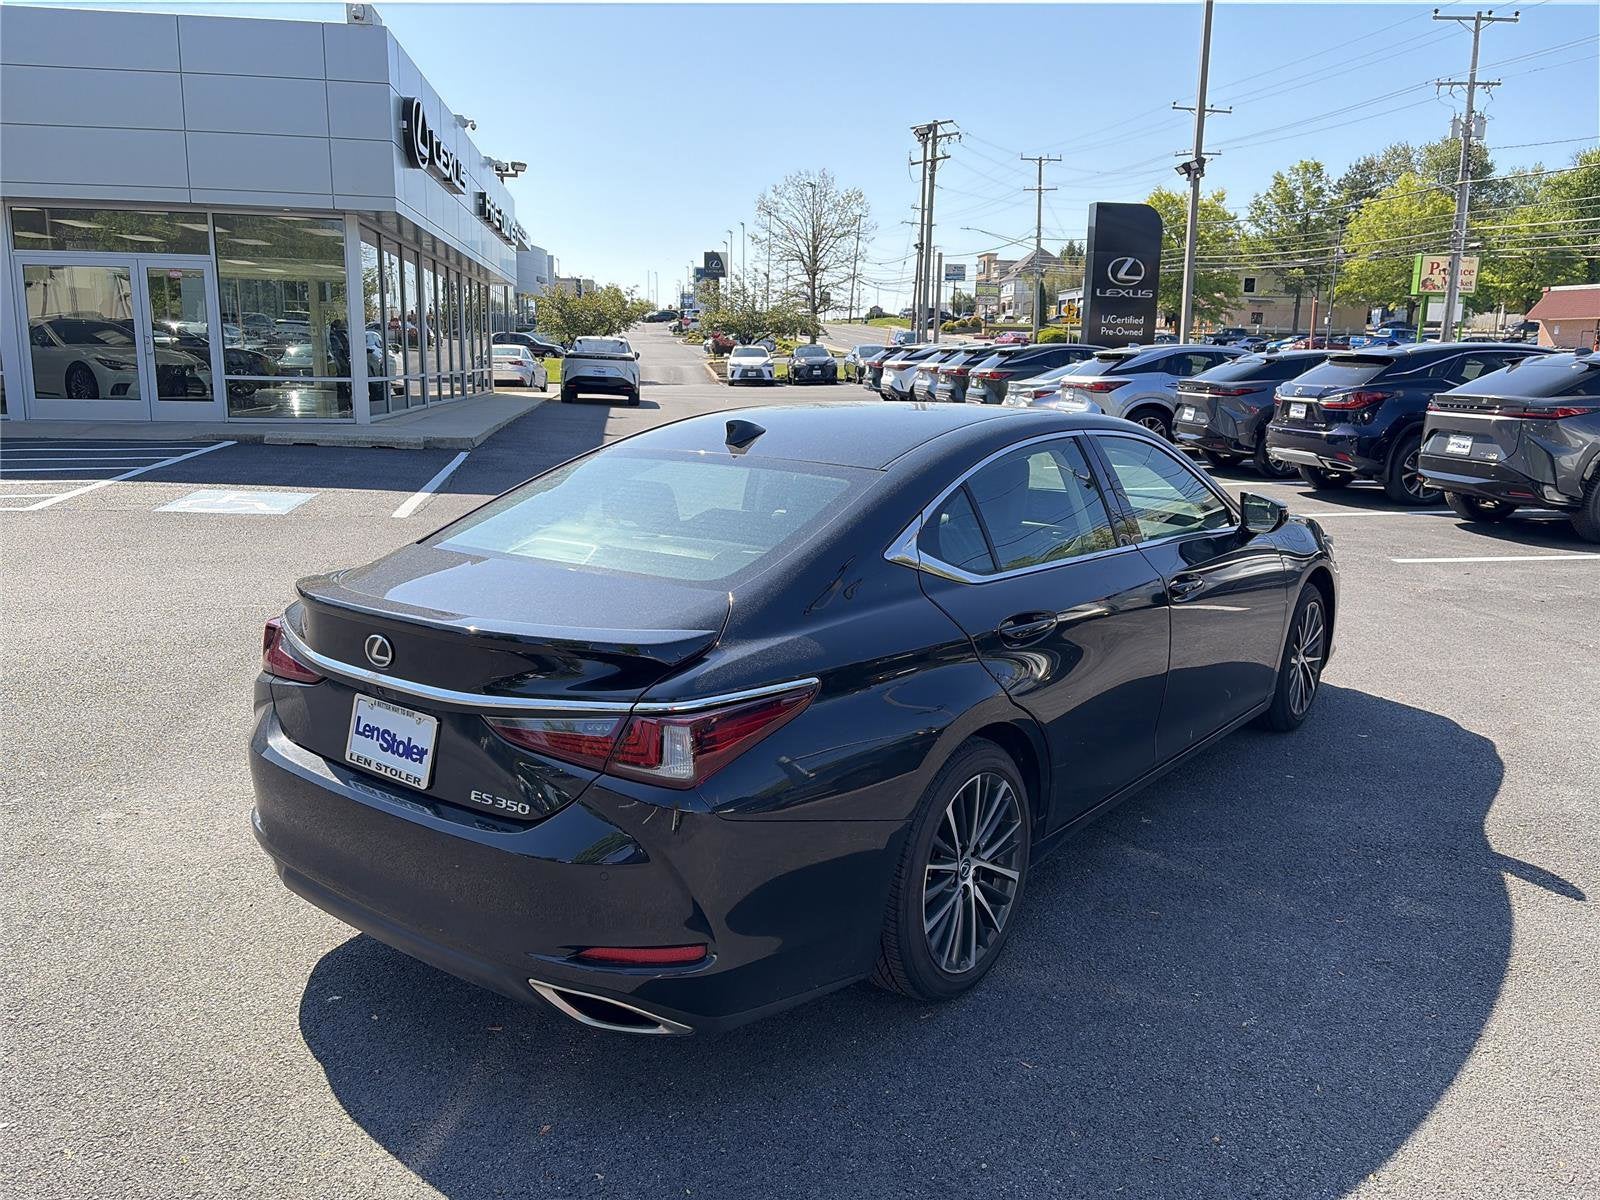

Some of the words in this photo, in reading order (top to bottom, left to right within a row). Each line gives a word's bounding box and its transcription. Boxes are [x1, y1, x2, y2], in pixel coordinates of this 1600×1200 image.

[431, 129, 467, 195] LEXUS
[1096, 288, 1154, 298] LEXUS
[1101, 314, 1145, 325] L/Certified
[1100, 326, 1144, 336] Pre-Owned
[349, 752, 372, 767] LEN
[375, 762, 422, 786] STOLER
[470, 790, 493, 805] ES
[494, 796, 530, 815] 350
